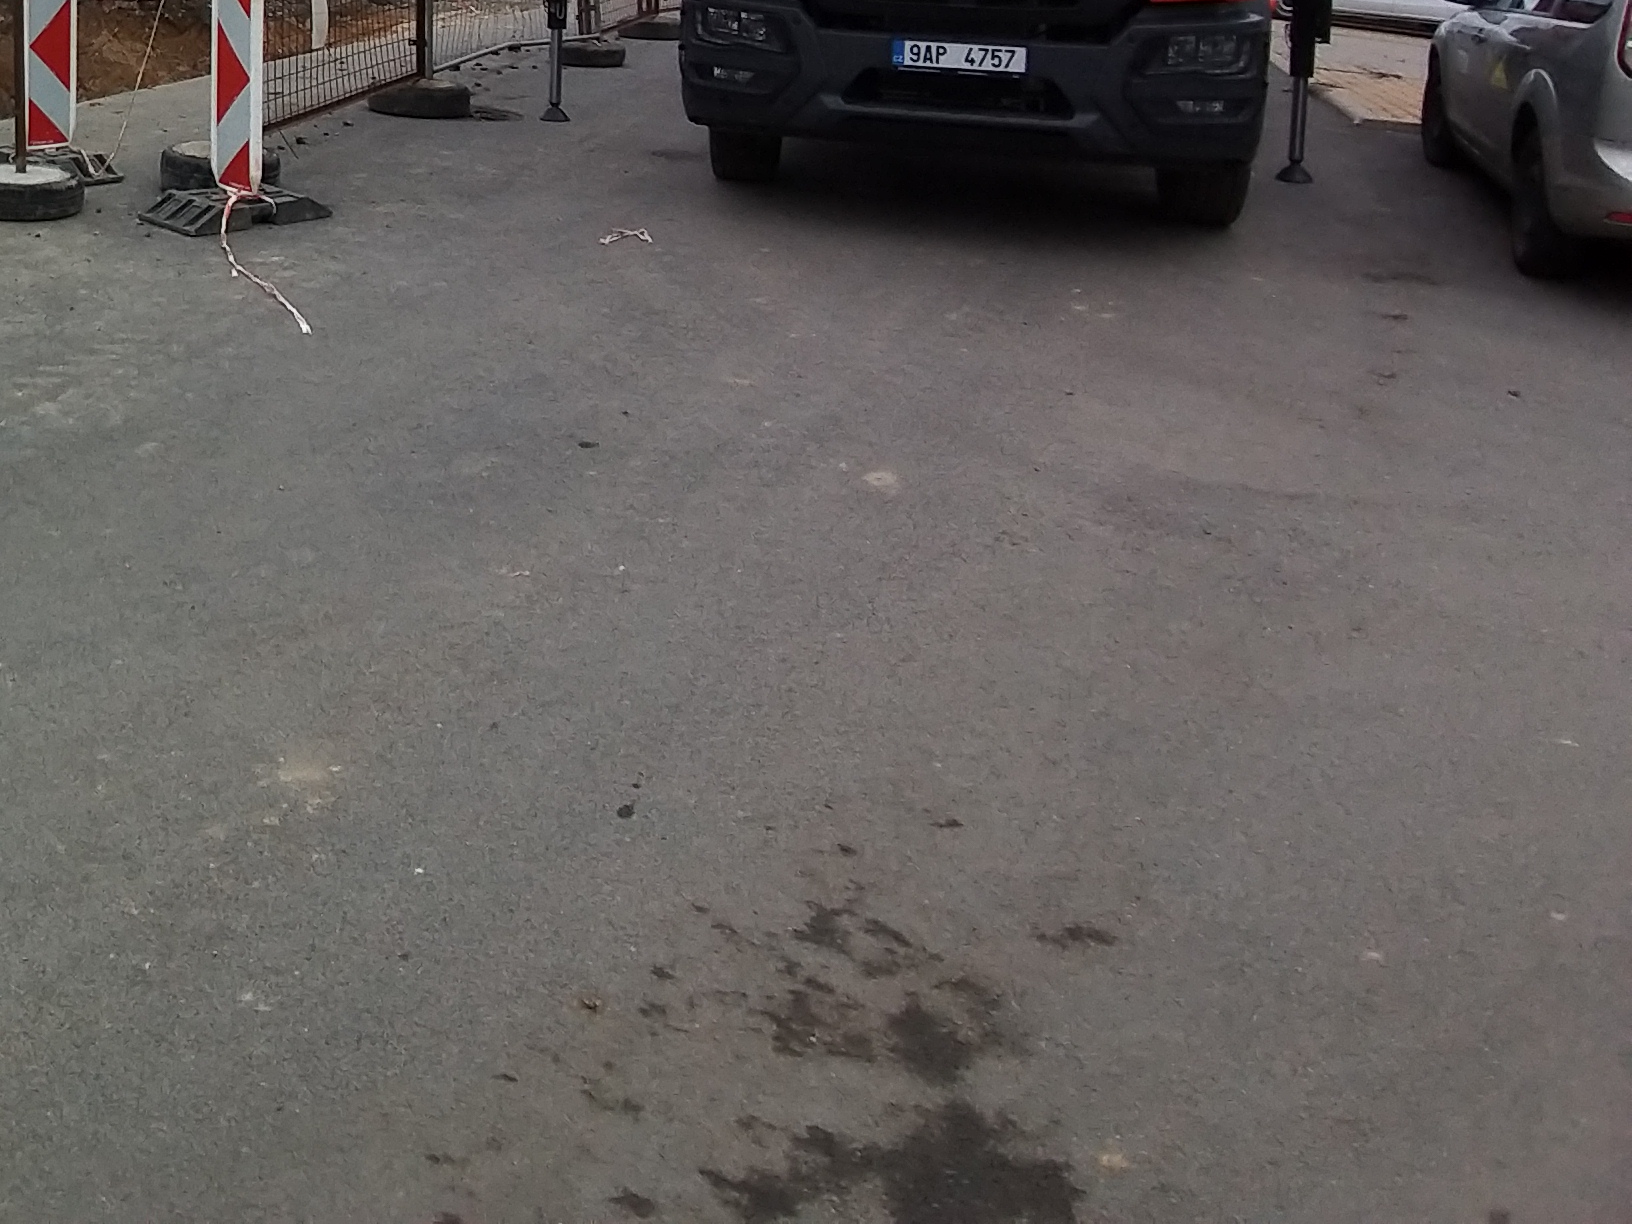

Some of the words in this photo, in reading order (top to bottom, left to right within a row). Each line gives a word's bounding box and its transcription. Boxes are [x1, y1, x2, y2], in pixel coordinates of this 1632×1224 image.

[893, 55, 903, 63] CZ
[909, 44, 947, 65] 9AP
[964, 47, 1016, 69] 4757
